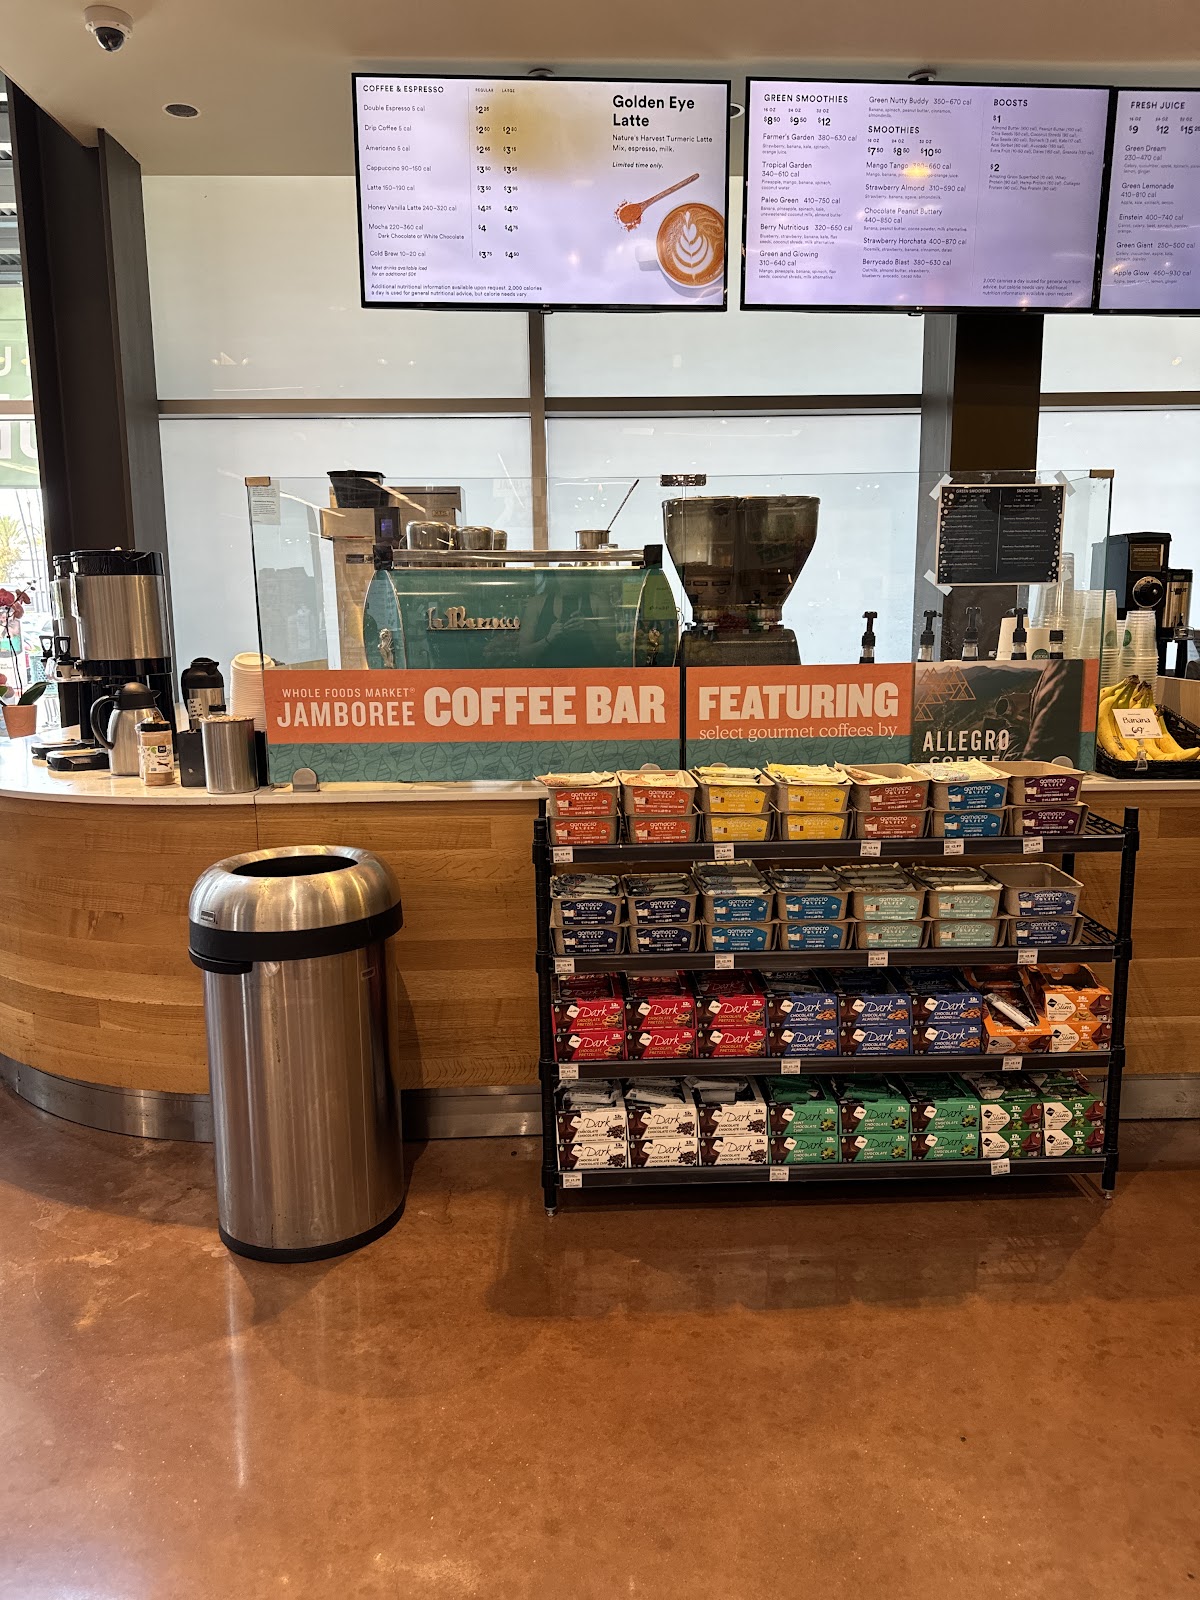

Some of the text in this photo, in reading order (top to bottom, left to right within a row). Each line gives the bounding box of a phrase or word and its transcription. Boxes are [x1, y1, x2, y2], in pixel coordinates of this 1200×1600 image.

[386, 105, 410, 113] Espresso
[613, 95, 694, 112] Golden Eye
[614, 114, 649, 126] Latte
[818, 118, 831, 126] $12
[1129, 125, 1138, 134] $9
[1156, 125, 1169, 134] $12
[444, 606, 521, 630] Marzocco
[282, 689, 320, 698] WHOLE
[325, 688, 361, 697] FOODS
[277, 686, 666, 727] JAMBOREE COFFEE BAR
[699, 682, 899, 720] FEATURING
[700, 722, 897, 743] select gourmet coffees by
[923, 729, 1010, 752] ALLEGRO
[722, 1002, 750, 1014] Dark
[794, 1000, 821, 1012] Dark
[797, 1108, 822, 1121] Dark
[584, 1116, 610, 1128] Dark
